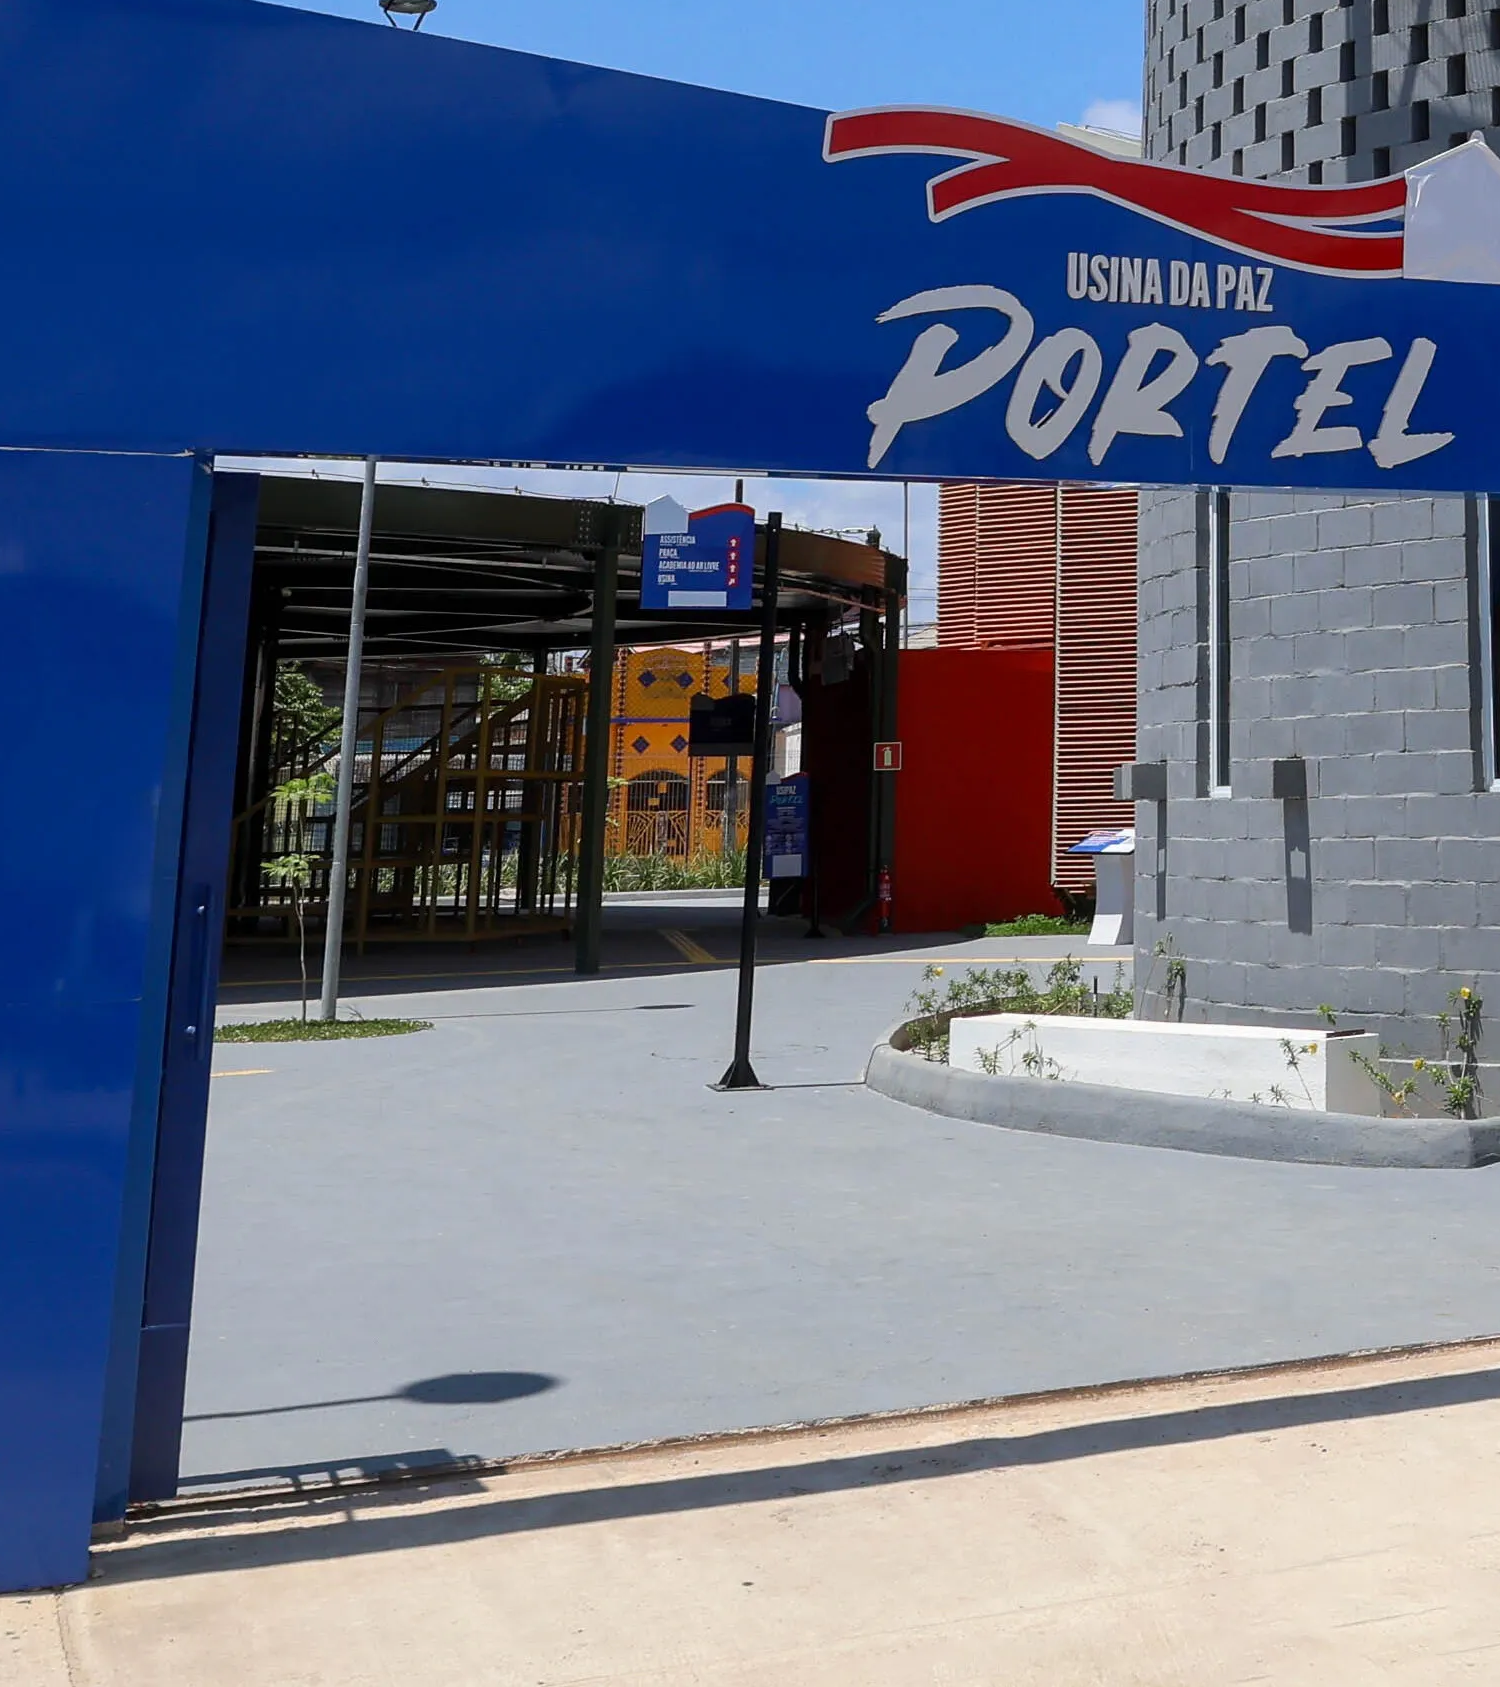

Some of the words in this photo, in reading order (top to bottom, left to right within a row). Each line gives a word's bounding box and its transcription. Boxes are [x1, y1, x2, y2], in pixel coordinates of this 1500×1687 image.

[1066, 252, 1164, 305] USINA
[1169, 260, 1211, 308] DA
[1216, 264, 1274, 312] PAZ
[866, 285, 1456, 469] PORTEL
